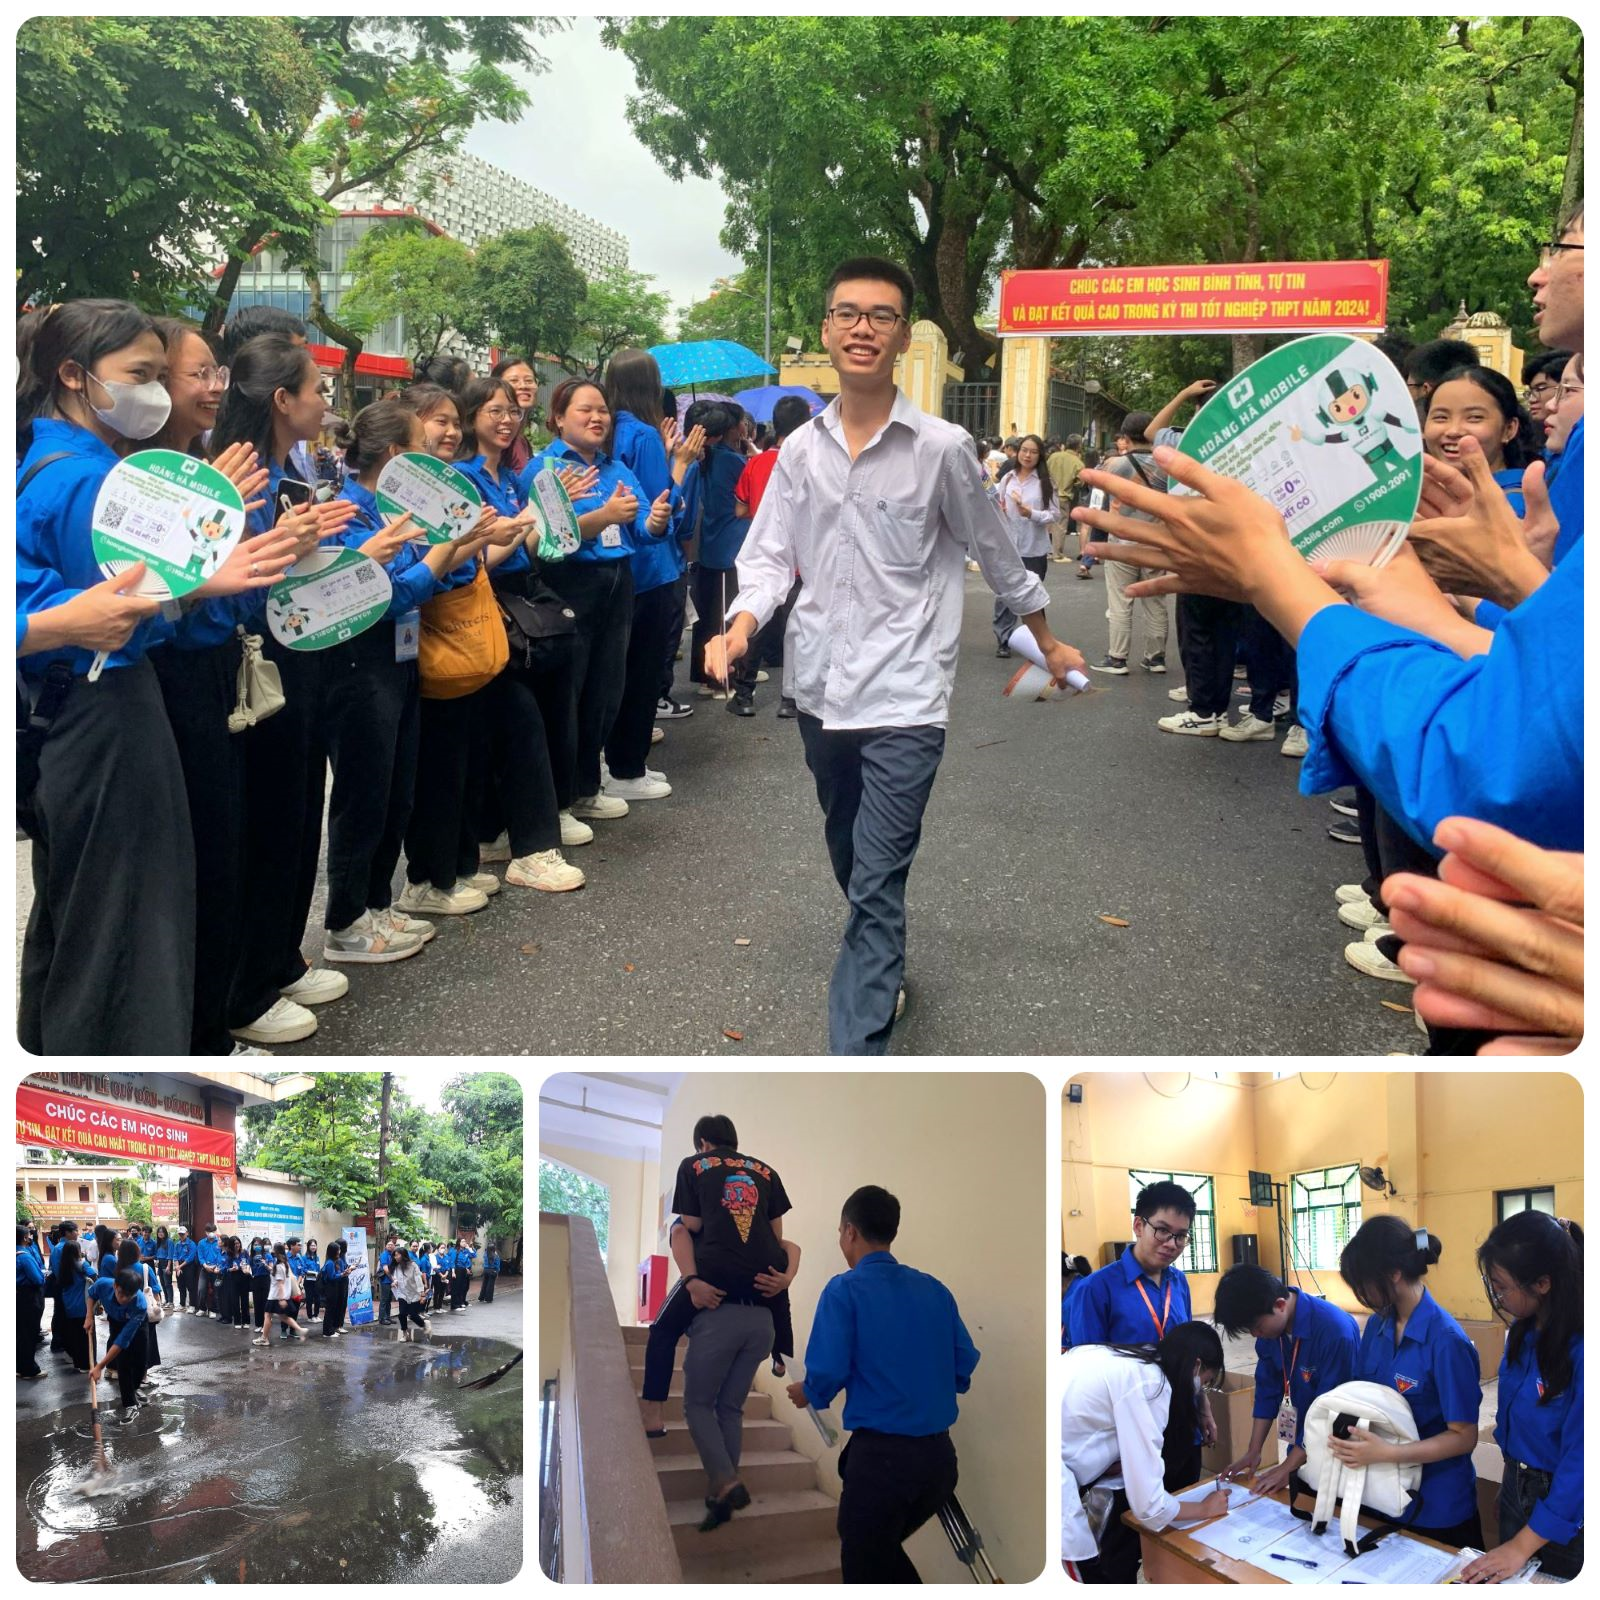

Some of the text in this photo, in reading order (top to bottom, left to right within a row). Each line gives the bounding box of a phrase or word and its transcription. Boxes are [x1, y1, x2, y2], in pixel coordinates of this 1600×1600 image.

[1070, 271, 1306, 296] CHÚC CÁC EM HỌC SINH BÌNH TĨNH, TỰ TIN
[1013, 303, 1026, 322] VÀ
[1029, 305, 1049, 325] ĐẠT
[1052, 300, 1071, 321] KẾT
[1073, 300, 1095, 322] QUẢ
[1097, 304, 1120, 320] CAO
[1123, 303, 1159, 320] TRONG
[1180, 302, 1198, 319] THI
[1201, 297, 1221, 319] TỐT
[1223, 298, 1267, 320] NGHIỆP
[1270, 300, 1300, 317] THPT
[1302, 296, 1331, 317] NĂM
[1334, 299, 1369, 316] 2024!
[1197, 421, 1239, 459] HOÀNG
[1239, 403, 1259, 426] HÀ
[1259, 364, 1309, 410] MOBILE
[45, 1102, 87, 1123] CHÚC
[89, 1110, 118, 1130] CÁC
[121, 1118, 137, 1134] EM
[140, 1122, 164, 1140] HỌC
[166, 1129, 188, 1143] SINH
[94, 1134, 107, 1148] CAO
[127, 1140, 147, 1155] TRONG
[157, 1146, 166, 1158] THI
